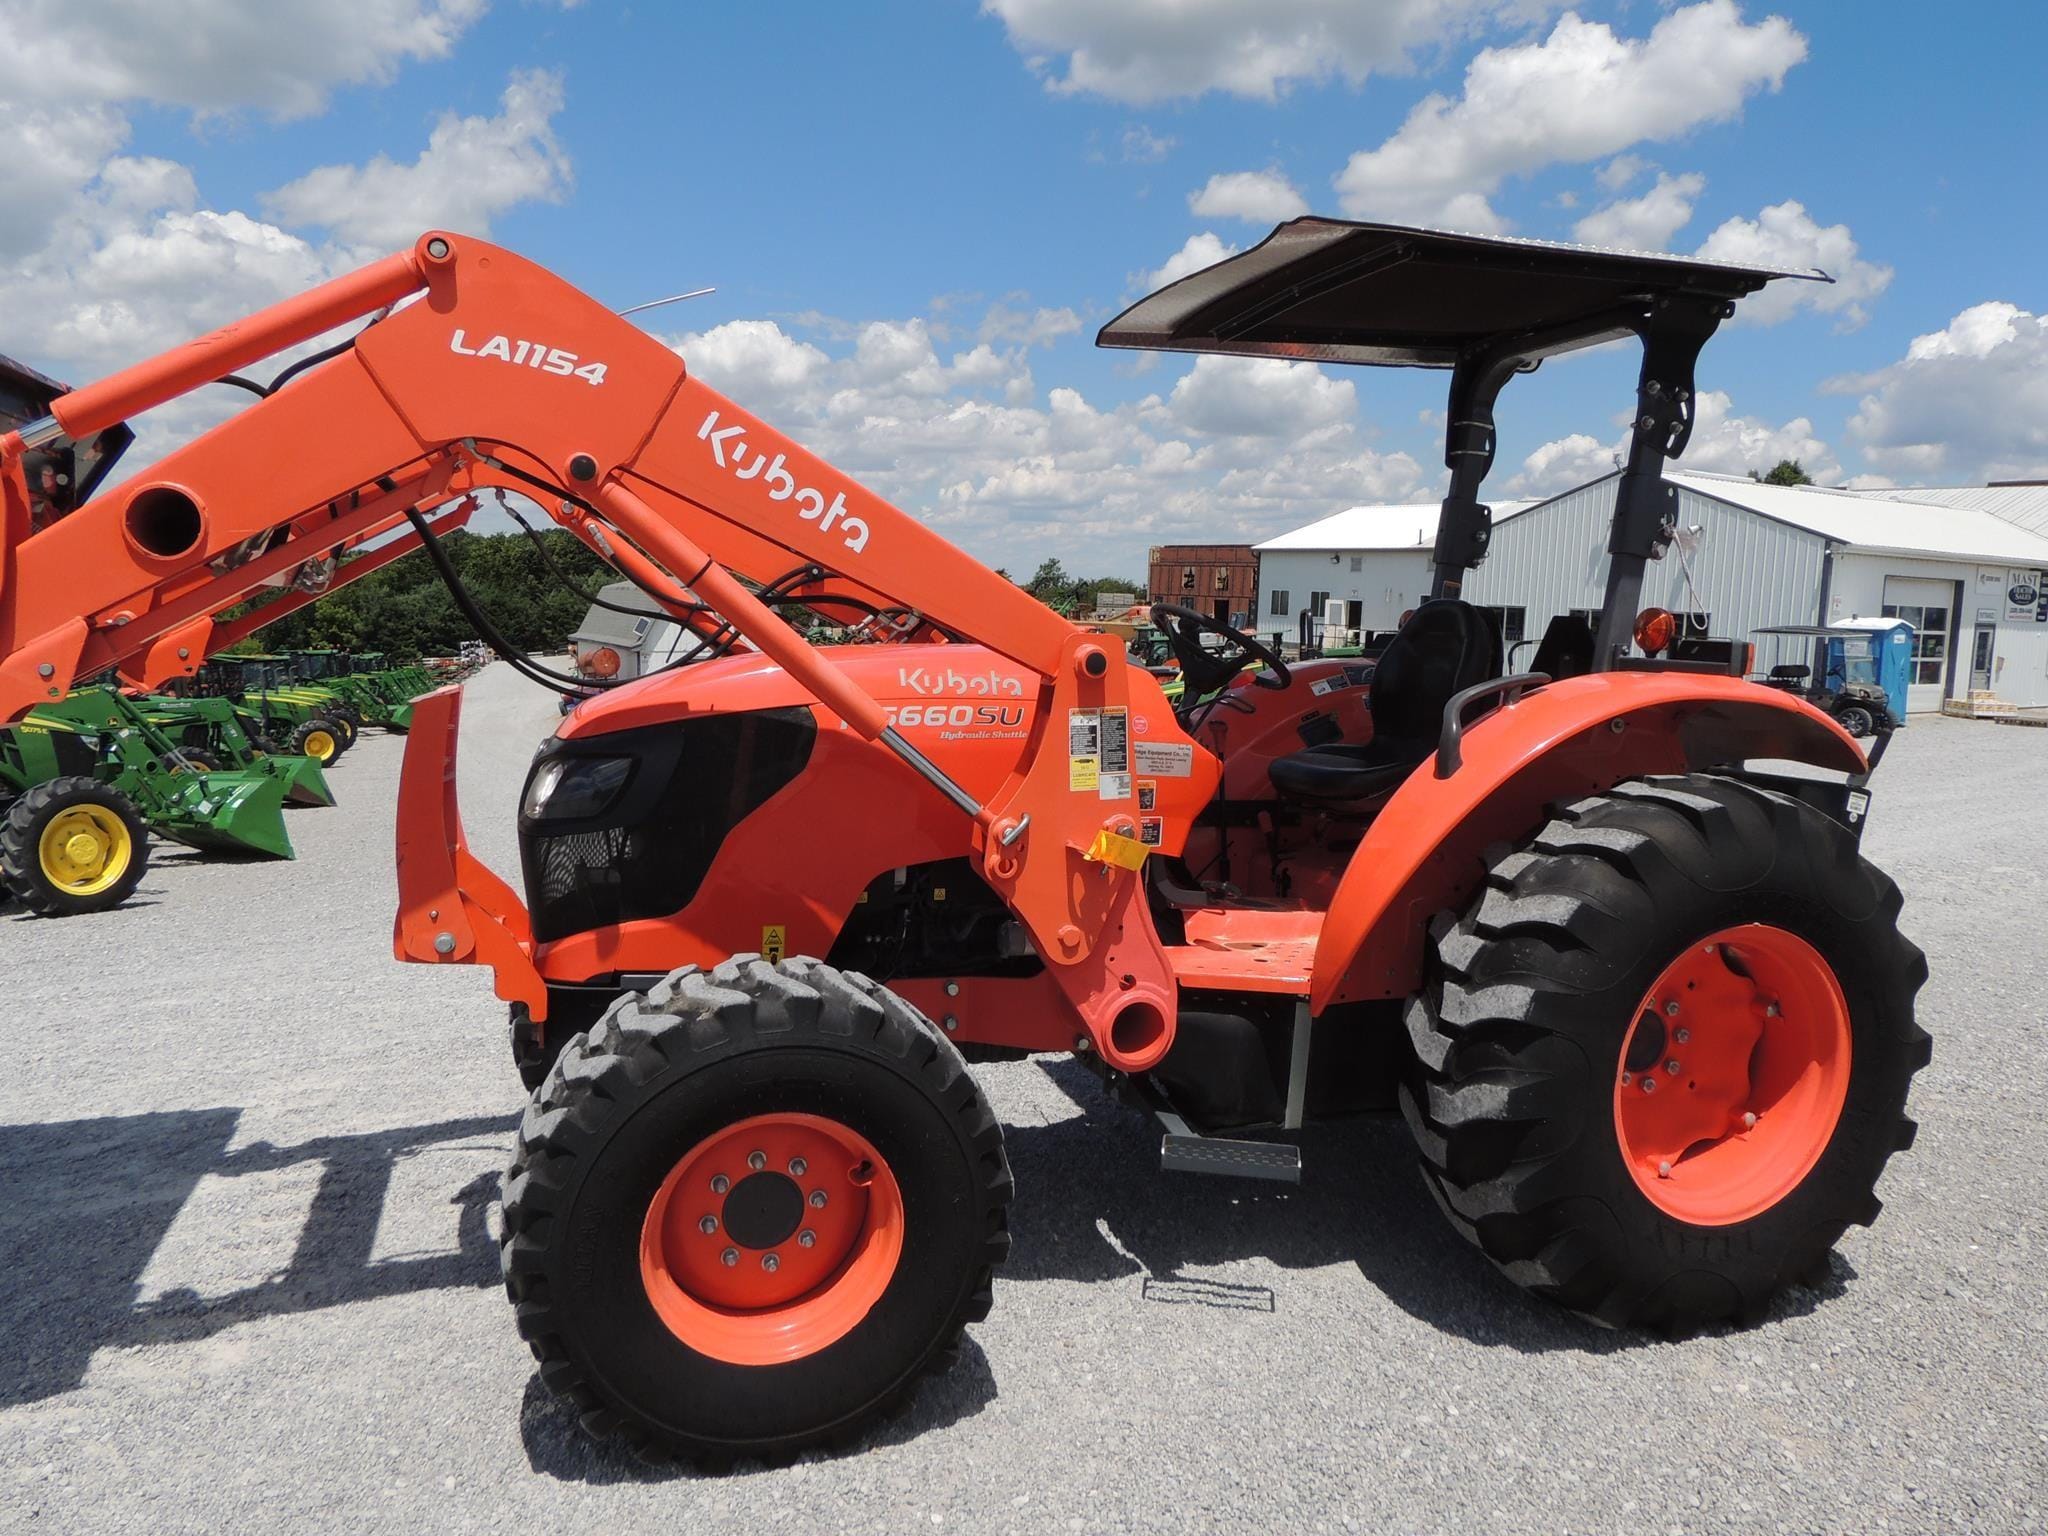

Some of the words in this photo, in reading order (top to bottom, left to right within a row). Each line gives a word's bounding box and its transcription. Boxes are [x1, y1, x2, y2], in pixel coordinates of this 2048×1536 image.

[450, 329, 608, 386] LA1154
[697, 411, 870, 554] Kubota
[899, 668, 1022, 696] Kubota
[940, 731, 990, 740] Hydraulic
[991, 731, 1028, 739] Shuttle
